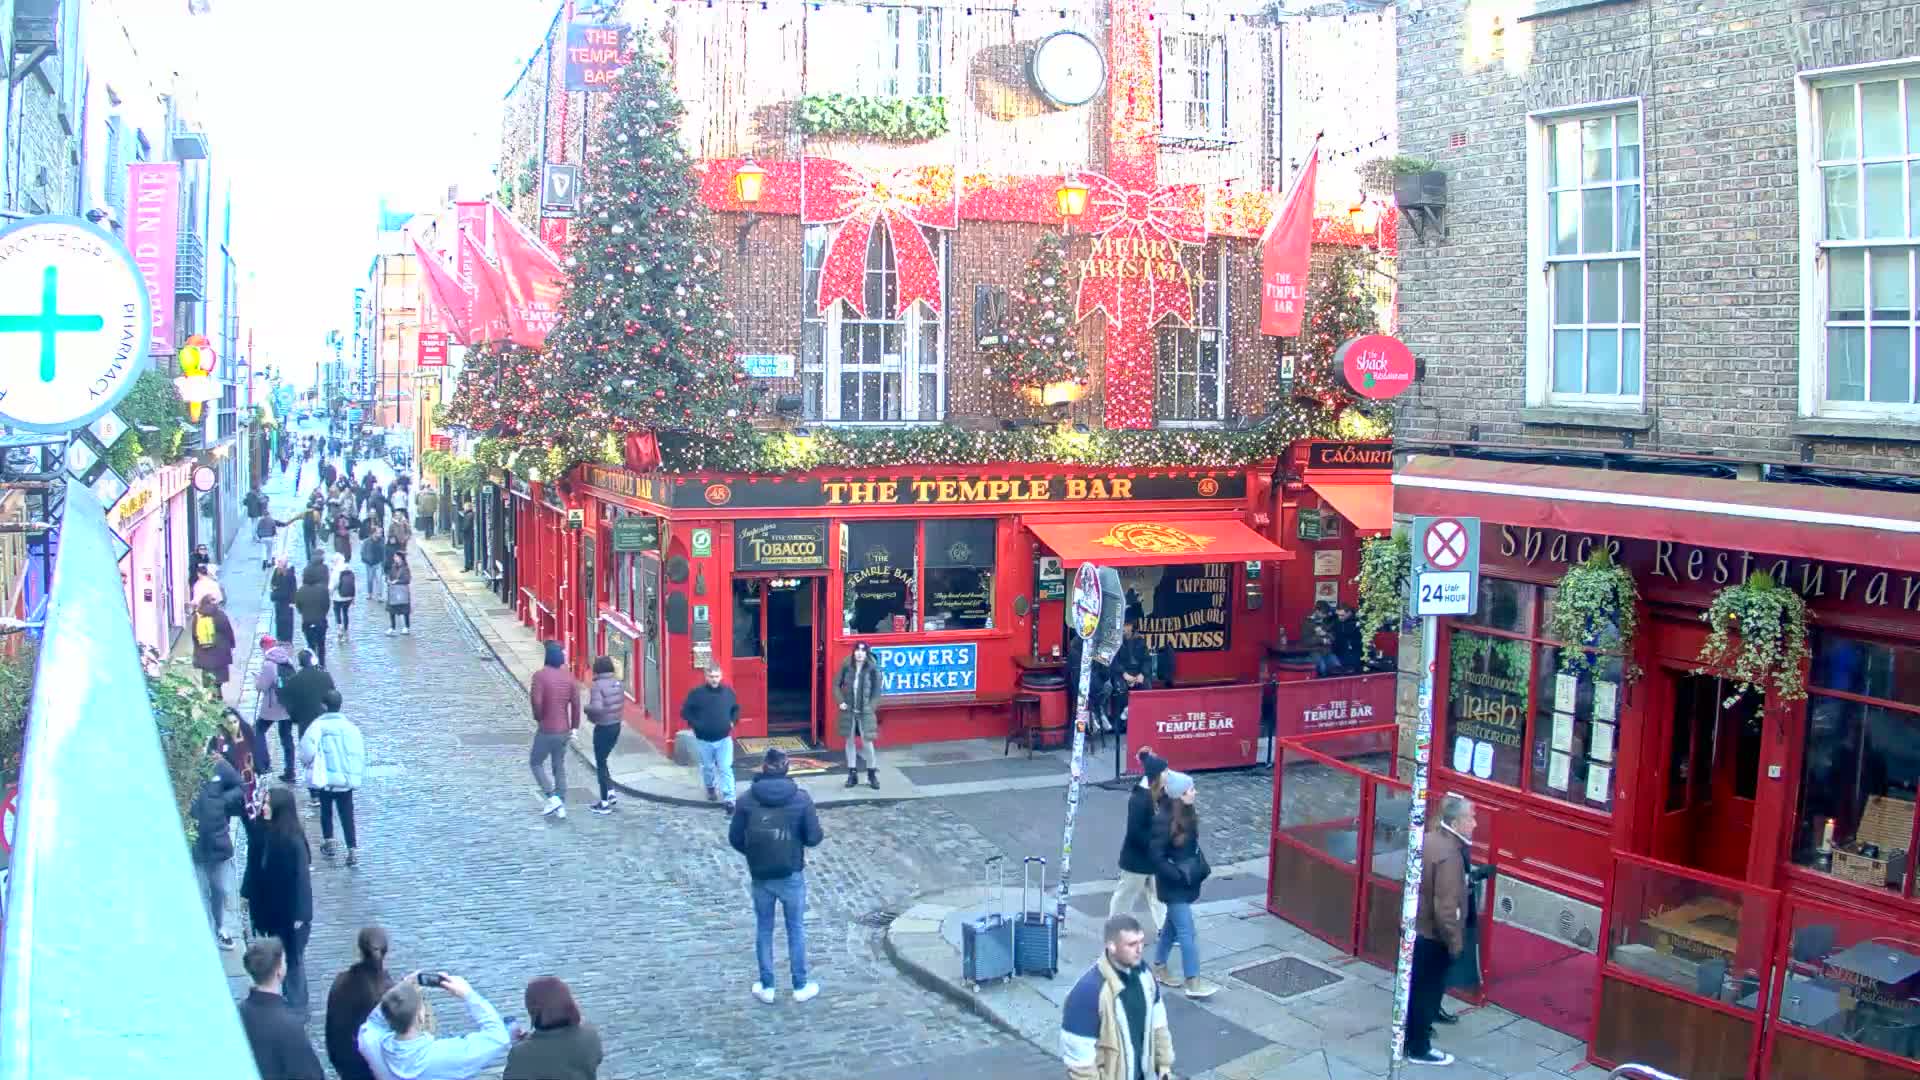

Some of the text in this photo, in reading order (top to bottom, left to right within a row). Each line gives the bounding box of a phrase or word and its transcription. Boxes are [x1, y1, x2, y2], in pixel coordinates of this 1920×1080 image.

[584, 30, 617, 45] THE
[568, 47, 622, 64] TEMPL
[136, 171, 168, 233] NINE
[1089, 236, 1183, 261] MERRY
[1275, 272, 1291, 285] THE
[88, 303, 135, 400] PHARMACY
[636, 477, 653, 499] BAR
[824, 478, 1133, 504] THE TEMPLE BAR
[751, 539, 816, 562] TOBACCO
[848, 565, 913, 588] TEMPLE BAR
[1203, 563, 1227, 578] THE
[1175, 578, 1226, 593] EMPEROR
[1422, 584, 1443, 602] 24
[1211, 593, 1225, 607] OF
[1444, 594, 1466, 602] HOUR
[1138, 608, 1226, 632] MALTED LIQUORS
[1144, 632, 1225, 649] UINNESS
[880, 648, 969, 668] POWER'S
[881, 670, 974, 690] WHISKEY
[1330, 700, 1348, 709] THE
[1186, 712, 1207, 721] THE
[1303, 705, 1373, 722] TEMPLE BAR
[1156, 717, 1234, 733] TEMPLE BAR
